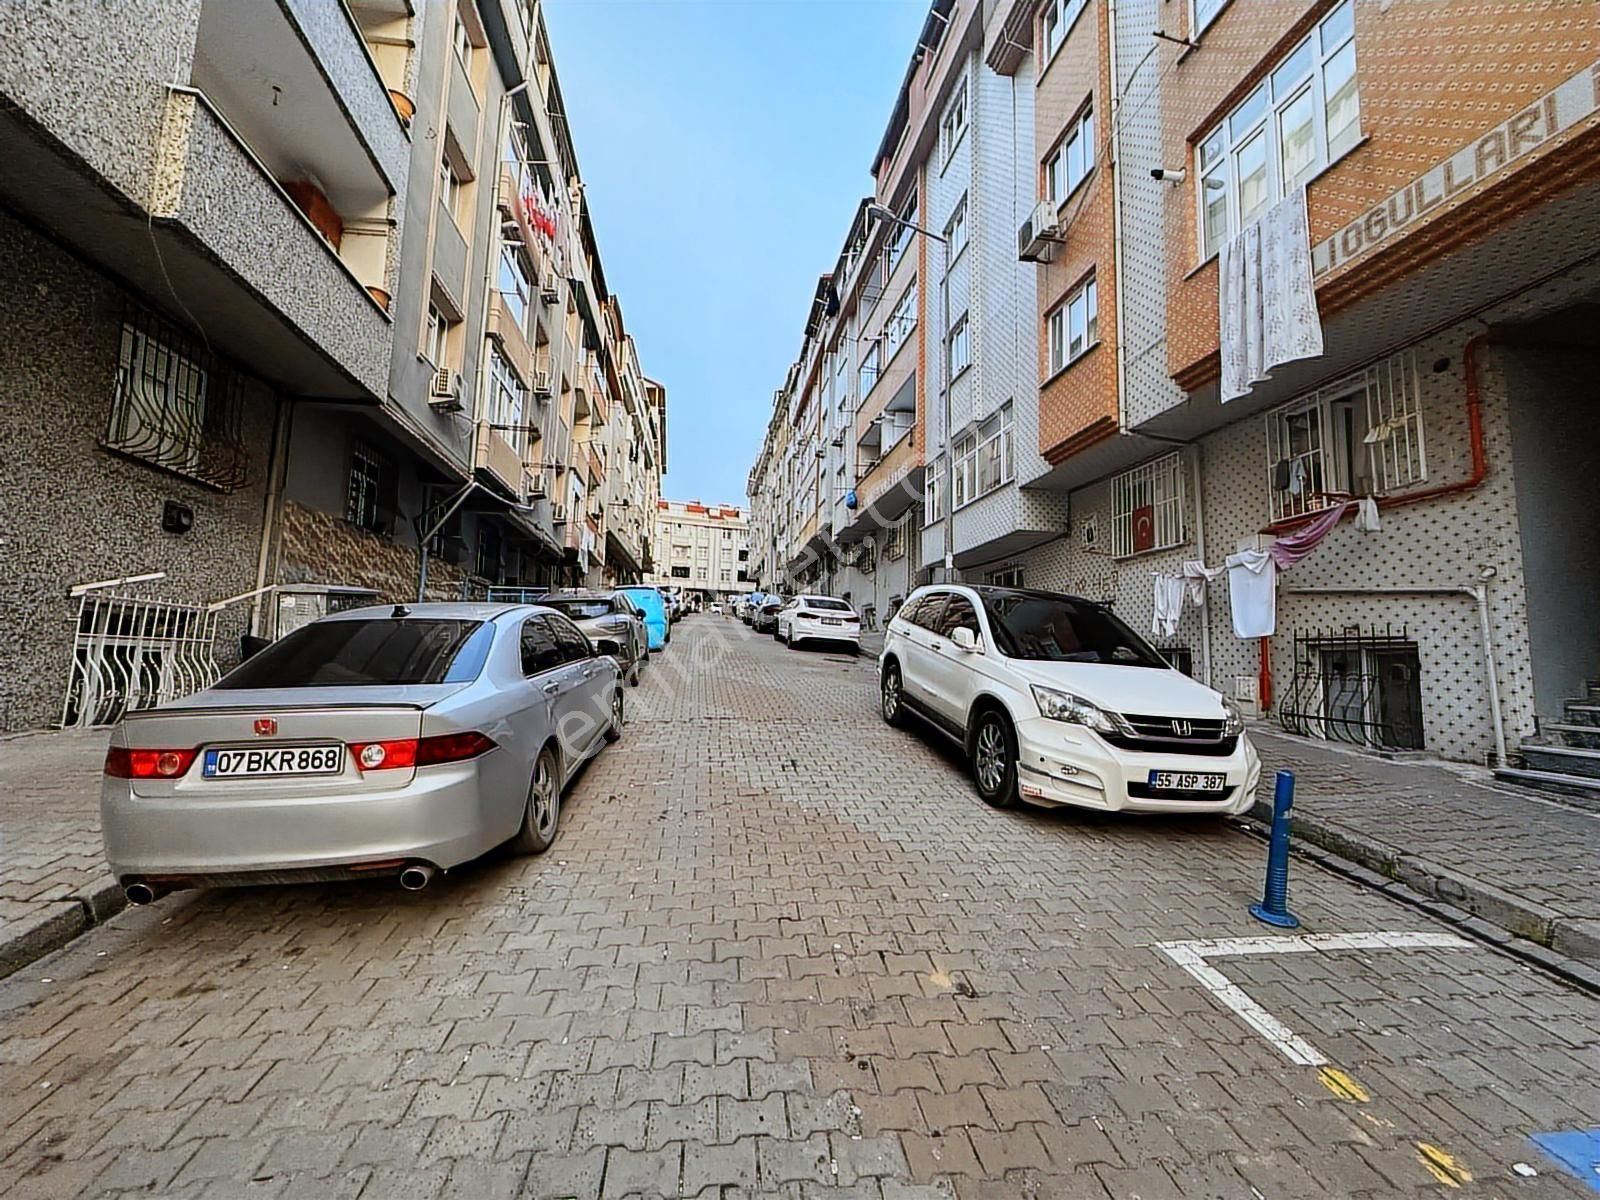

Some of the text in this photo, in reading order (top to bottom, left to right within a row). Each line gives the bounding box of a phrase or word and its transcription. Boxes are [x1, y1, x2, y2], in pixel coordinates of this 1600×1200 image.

[1157, 773, 1224, 789] 55 ASP 387
